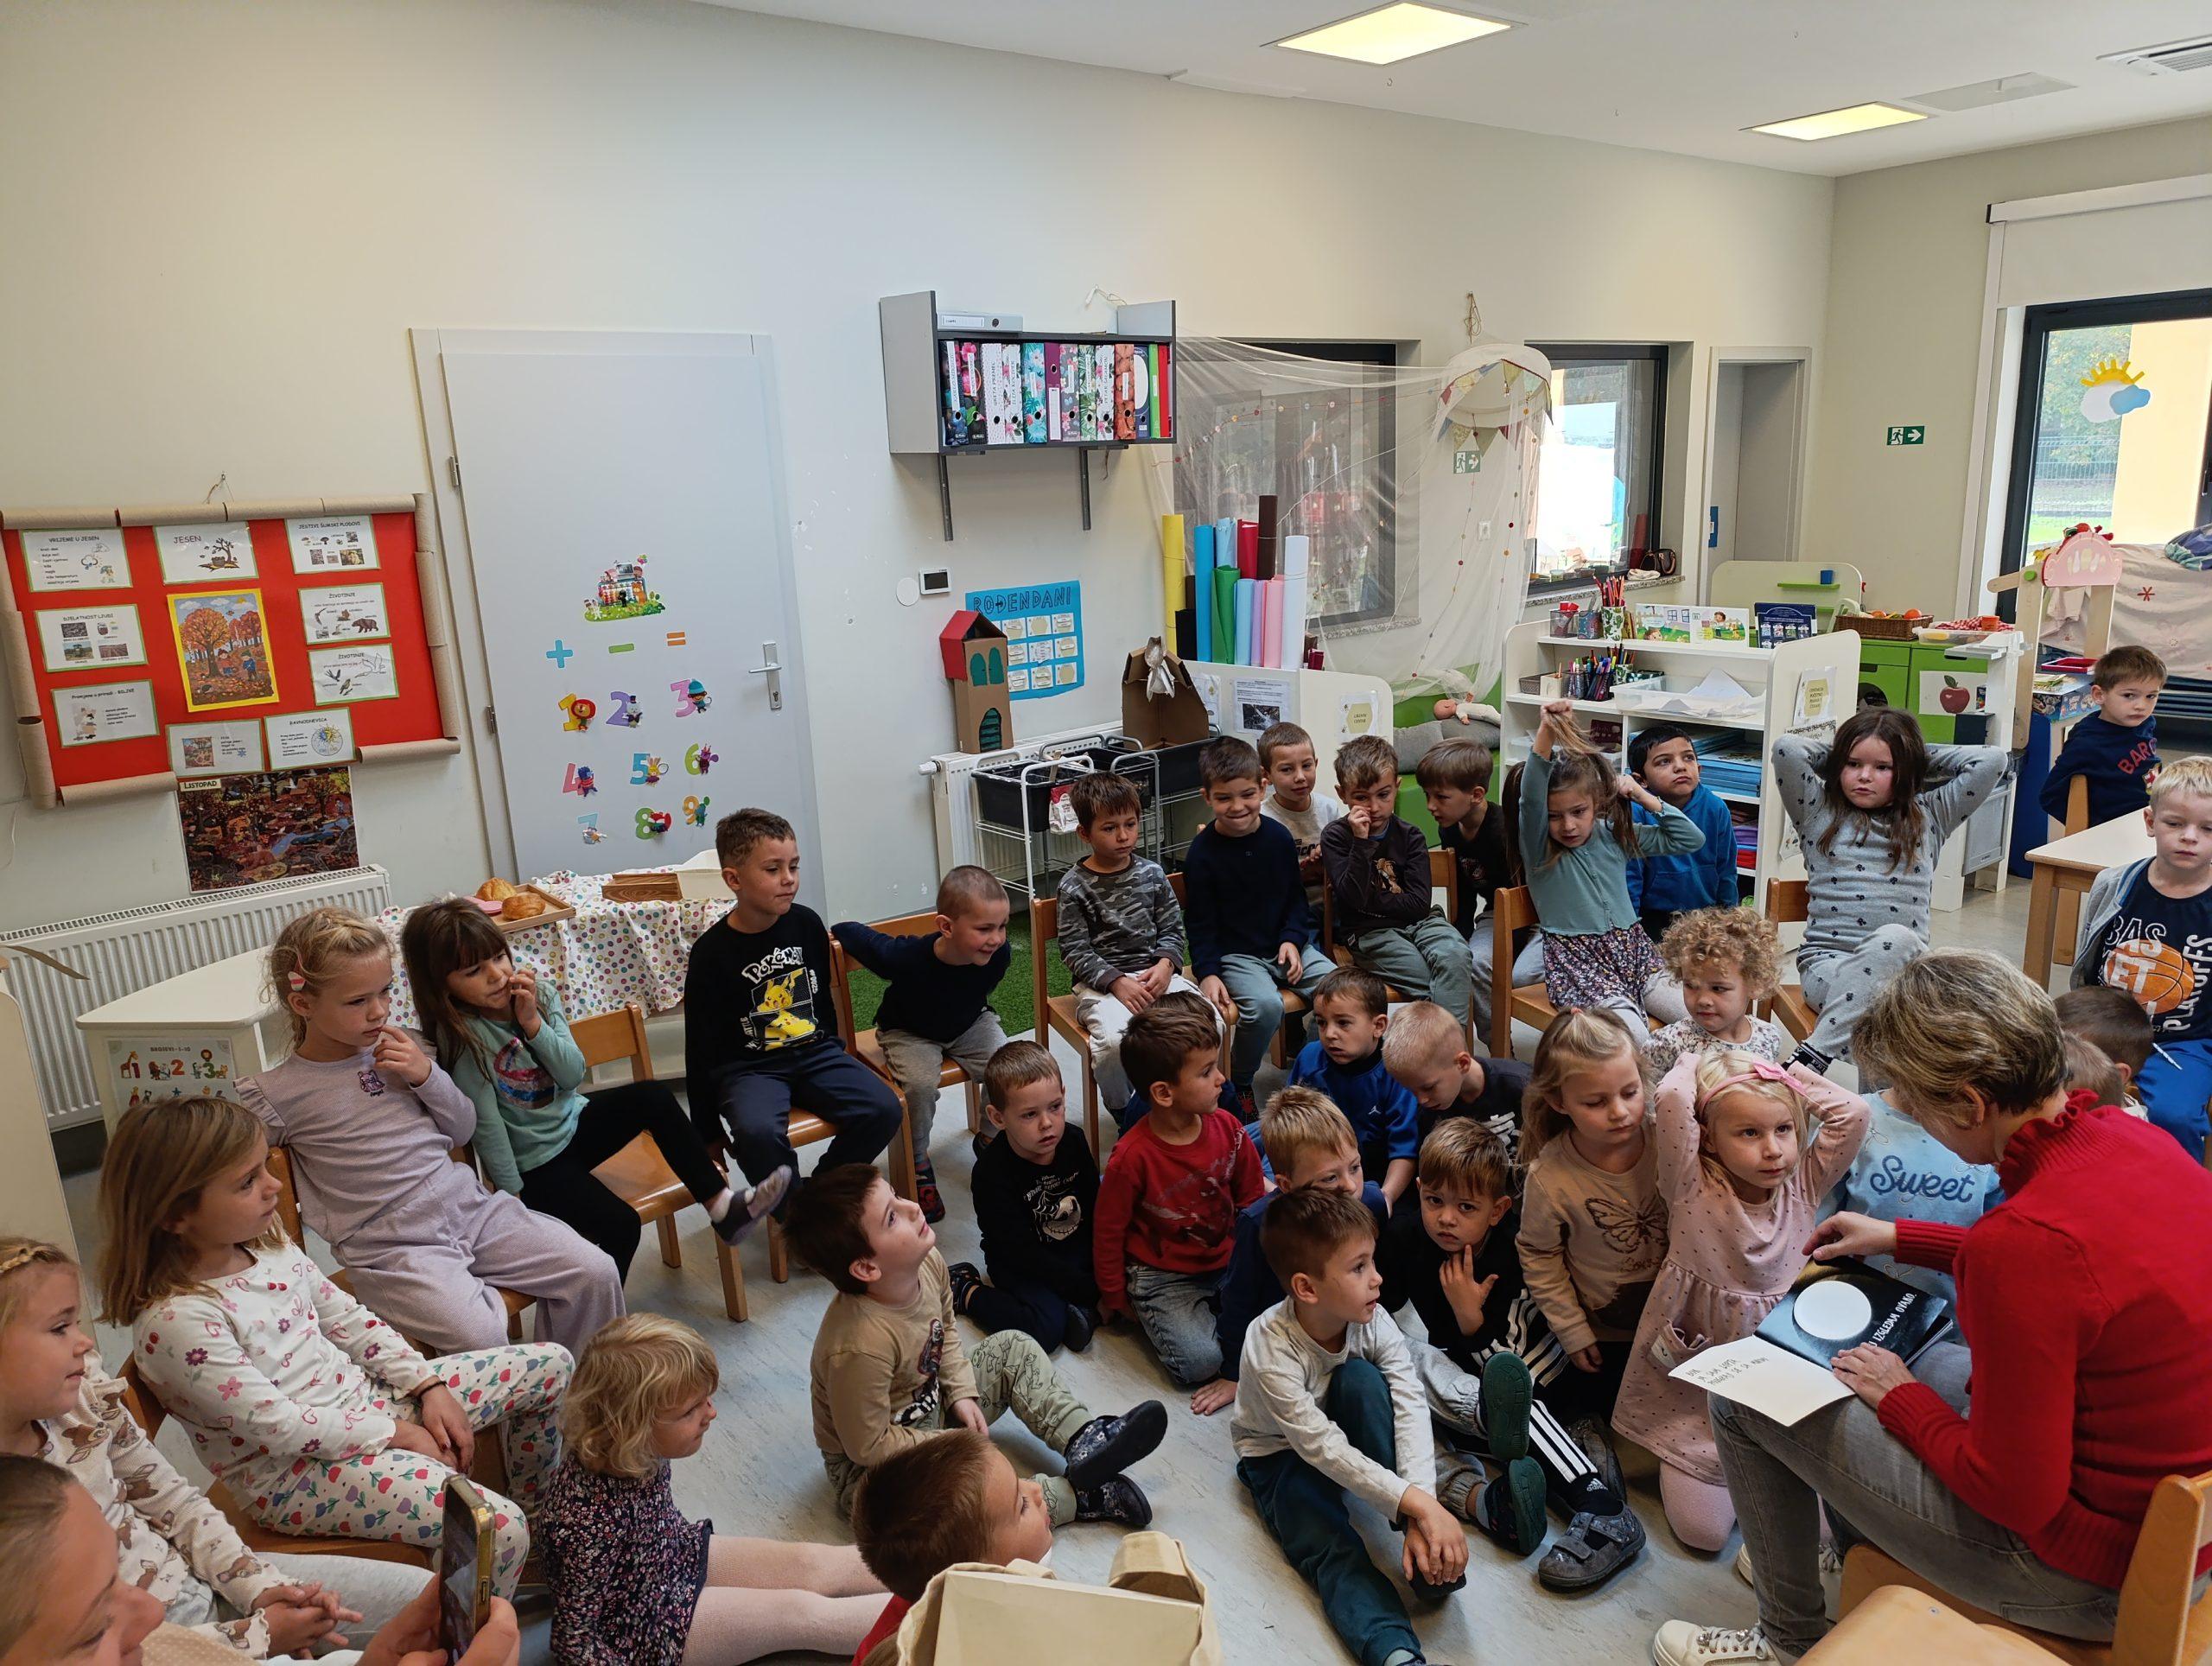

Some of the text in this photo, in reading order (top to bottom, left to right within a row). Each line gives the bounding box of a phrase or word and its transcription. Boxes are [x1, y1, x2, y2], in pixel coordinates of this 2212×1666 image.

[173, 535, 201, 544] JESEN
[670, 678, 696, 717] 3
[184, 780, 218, 789] LISTOPAD
[170, 1059, 185, 1076] 2
[202, 1062, 216, 1079] 3
[1870, 1154, 1975, 1203] Sweet
[1872, 1313, 1900, 1341] IZGLEDAM
[1586, 1484, 1609, 1492] adidas
